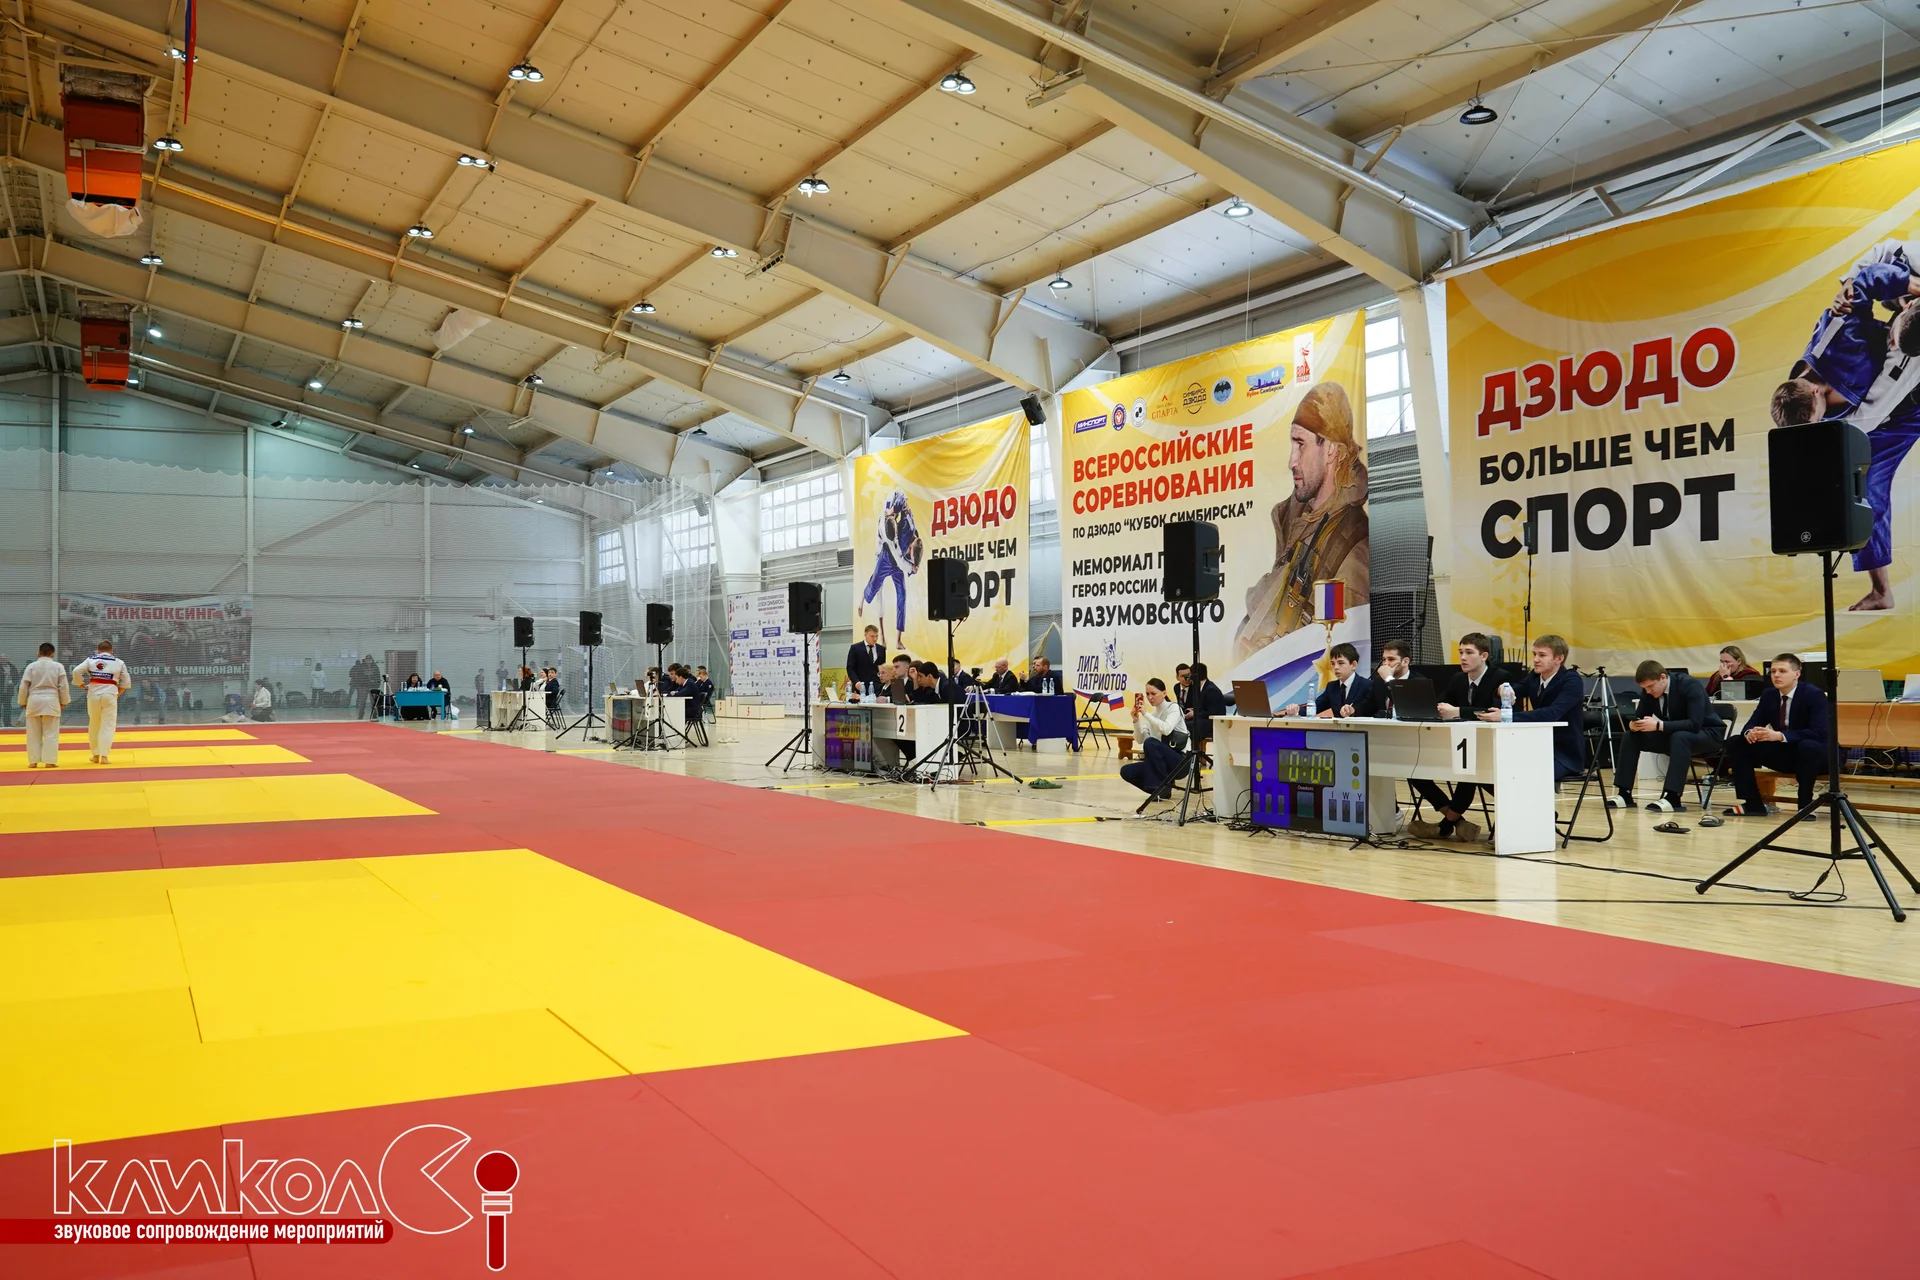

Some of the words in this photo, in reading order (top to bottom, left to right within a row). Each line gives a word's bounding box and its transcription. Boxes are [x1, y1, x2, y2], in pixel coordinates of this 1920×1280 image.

[1260, 385, 1285, 395] Симбирска
[1478, 327, 1736, 437] ДЗЮДО
[1182, 387, 1207, 399] СИМБИРСК
[1182, 393, 1207, 407] ДЗЮДО
[1077, 416, 1107, 429] МИНСПОРТ
[1151, 406, 1179, 420] СПАРТА
[1073, 423, 1253, 483] ВСЕРОССИЙСКИЕ
[1480, 433, 1632, 485] БОЛЬШЕ
[1644, 418, 1735, 460] ЧЕМ
[1072, 459, 1254, 515] СОРЕВНОВАНИЯ
[931, 485, 1017, 537] ДЗЮДО
[1481, 473, 1735, 559] СПОРТ
[1072, 524, 1086, 539] ПО
[1087, 520, 1122, 539] ДЗЮДО
[988, 538, 1017, 559] ЧЕМ
[1072, 552, 1154, 577] МЕМОРИАЛ
[1072, 581, 1107, 598] ГЕРОЯ
[1109, 578, 1158, 595] РОССИИ
[107, 607, 216, 621] КИКБОКСИНГ
[1072, 599, 1225, 628] РАЗУМОВСКОГО
[175, 664, 245, 675] чемпионам!
[1077, 655, 1099, 672] ЛИГА
[1077, 673, 1128, 691] ПАТРИОТОВ
[898, 714, 905, 732] 2
[1456, 737, 1467, 769] 1
[1288, 750, 1334, 784] 0:04
[1342, 791, 1350, 800] W
[1357, 793, 1363, 801] Y
